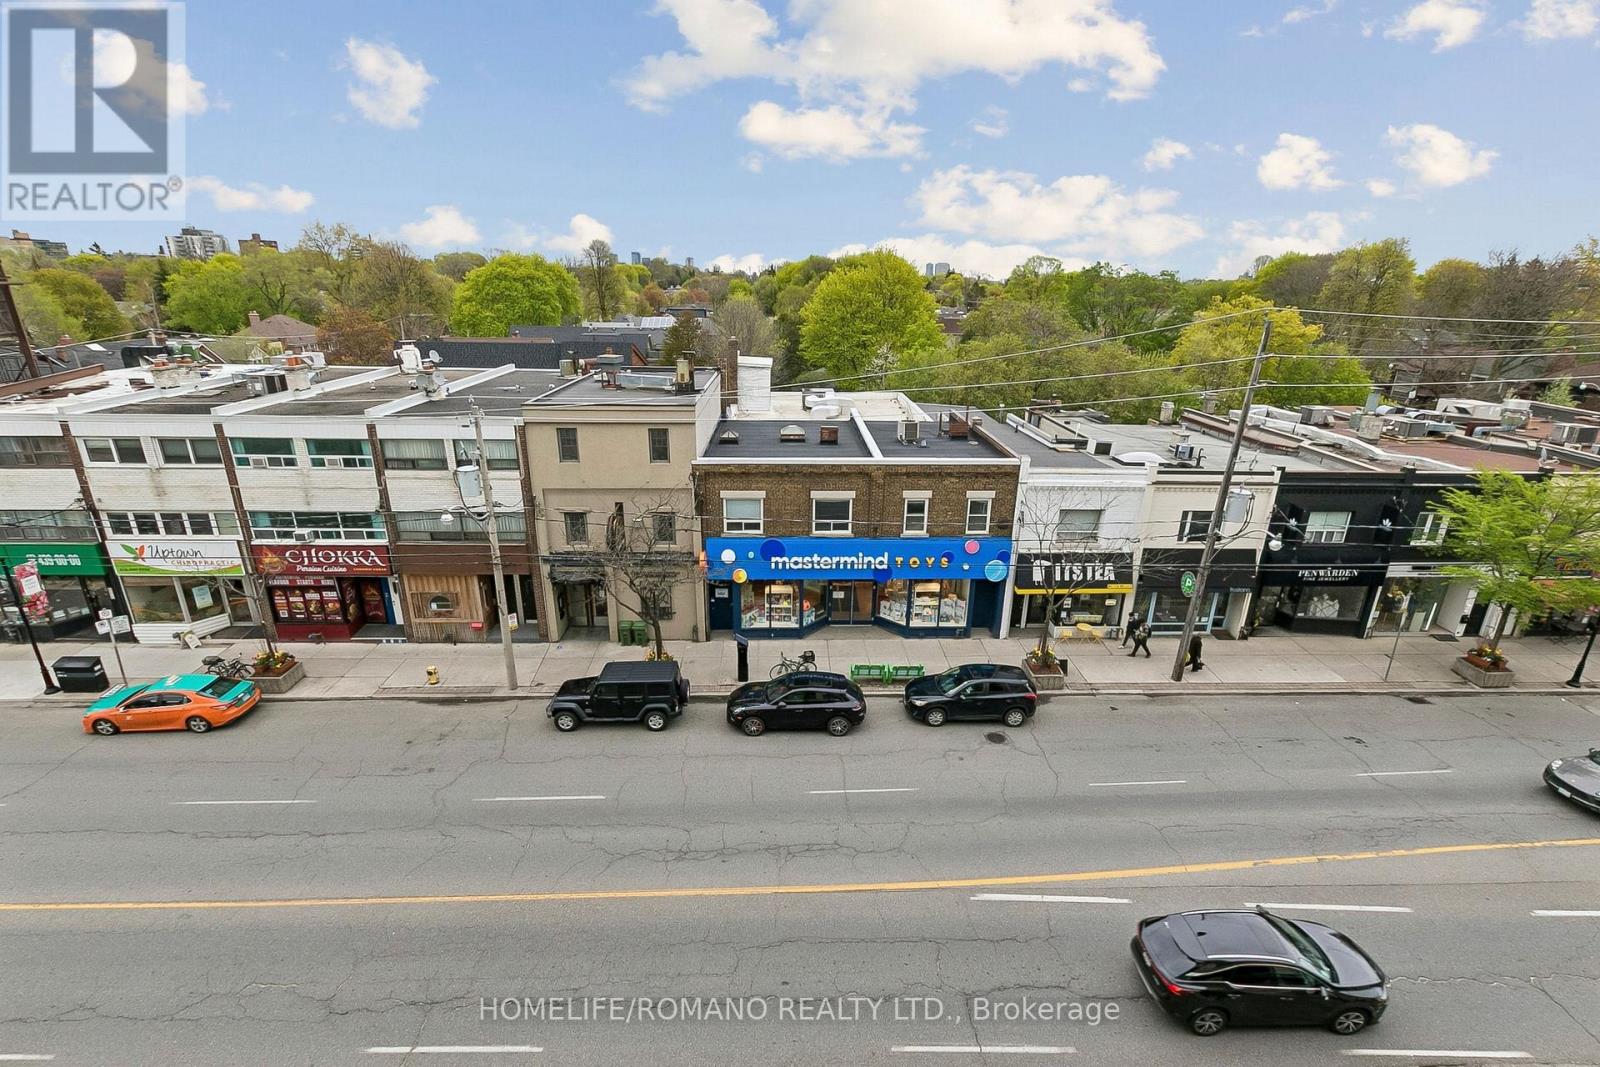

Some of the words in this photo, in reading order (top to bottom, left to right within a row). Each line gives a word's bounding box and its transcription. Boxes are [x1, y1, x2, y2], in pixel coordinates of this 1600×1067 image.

[148, 545, 204, 563] Uptown
[285, 548, 387, 566] CHOKKA
[771, 552, 889, 570] mastermind
[895, 557, 950, 568] TOYS
